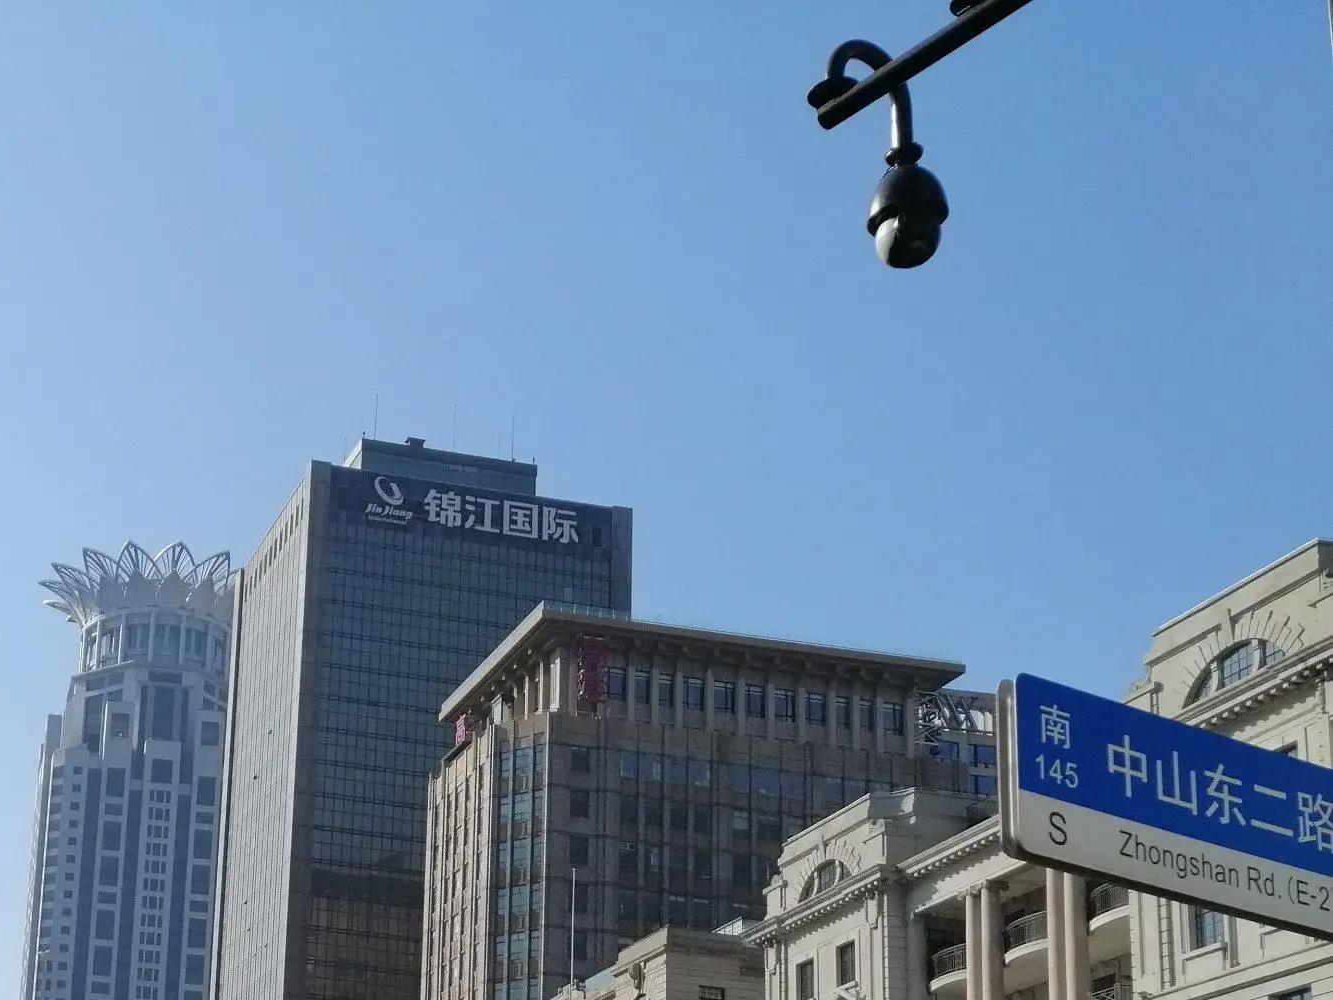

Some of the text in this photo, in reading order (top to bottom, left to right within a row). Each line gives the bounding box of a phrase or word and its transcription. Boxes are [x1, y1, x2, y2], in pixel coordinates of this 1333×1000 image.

[424, 488, 578, 543] 锦江国际
[1039, 704, 1070, 749] 南
[1035, 754, 1078, 788] 145
[1107, 735, 1333, 854] 中山东二路
[1048, 811, 1067, 845] S
[1119, 830, 1333, 912] Zhongshan Rd. (E-2
